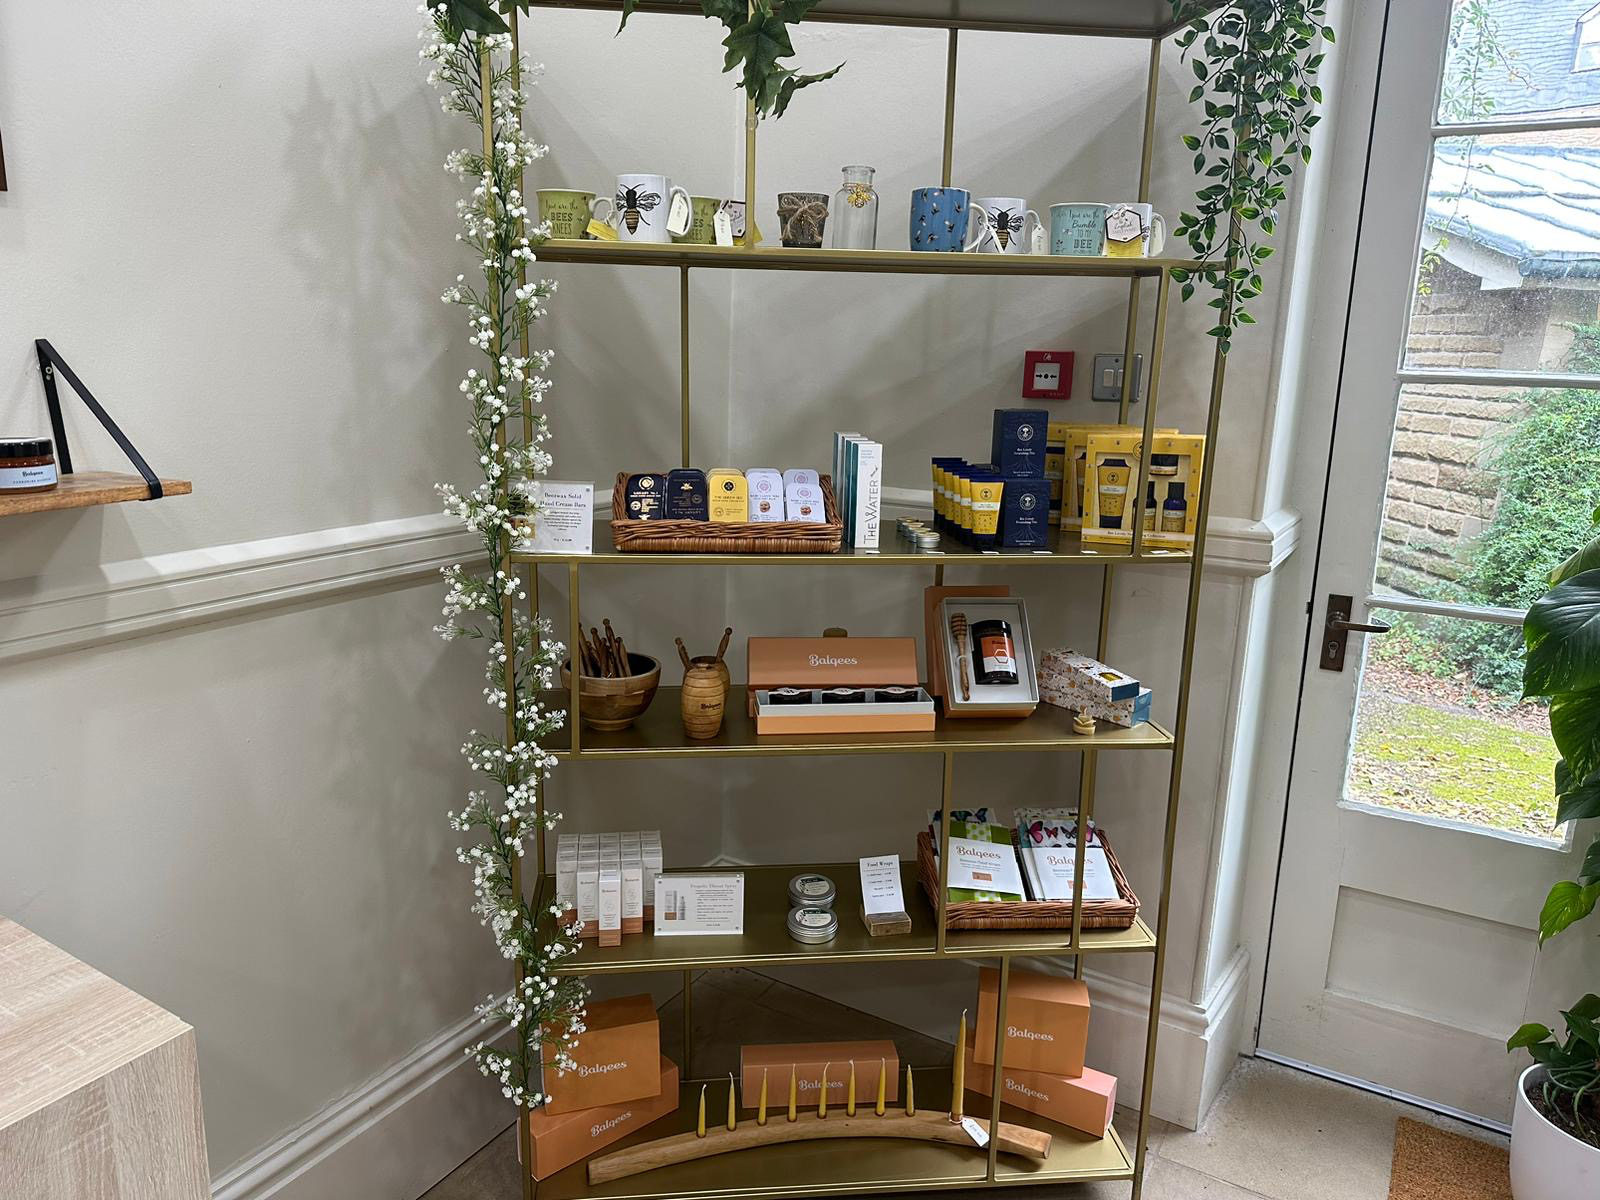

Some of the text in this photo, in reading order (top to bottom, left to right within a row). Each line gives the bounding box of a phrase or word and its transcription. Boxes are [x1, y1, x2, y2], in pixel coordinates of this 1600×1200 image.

[551, 212, 573, 222] BEES
[693, 218, 704, 228] ES
[552, 222, 572, 235] KNEES
[1072, 220, 1096, 229] Bumble
[1073, 239, 1093, 249] BEE
[864, 479, 879, 544] THE WATER
[808, 654, 858, 667] Balqees
[956, 846, 1001, 858] Balqees
[1046, 855, 1094, 866] Balqs
[1007, 1025, 1054, 1041] Balqees
[577, 1060, 628, 1077] Balqees
[1005, 1078, 1049, 1101] Balqees
[590, 1110, 632, 1137] Balqees
